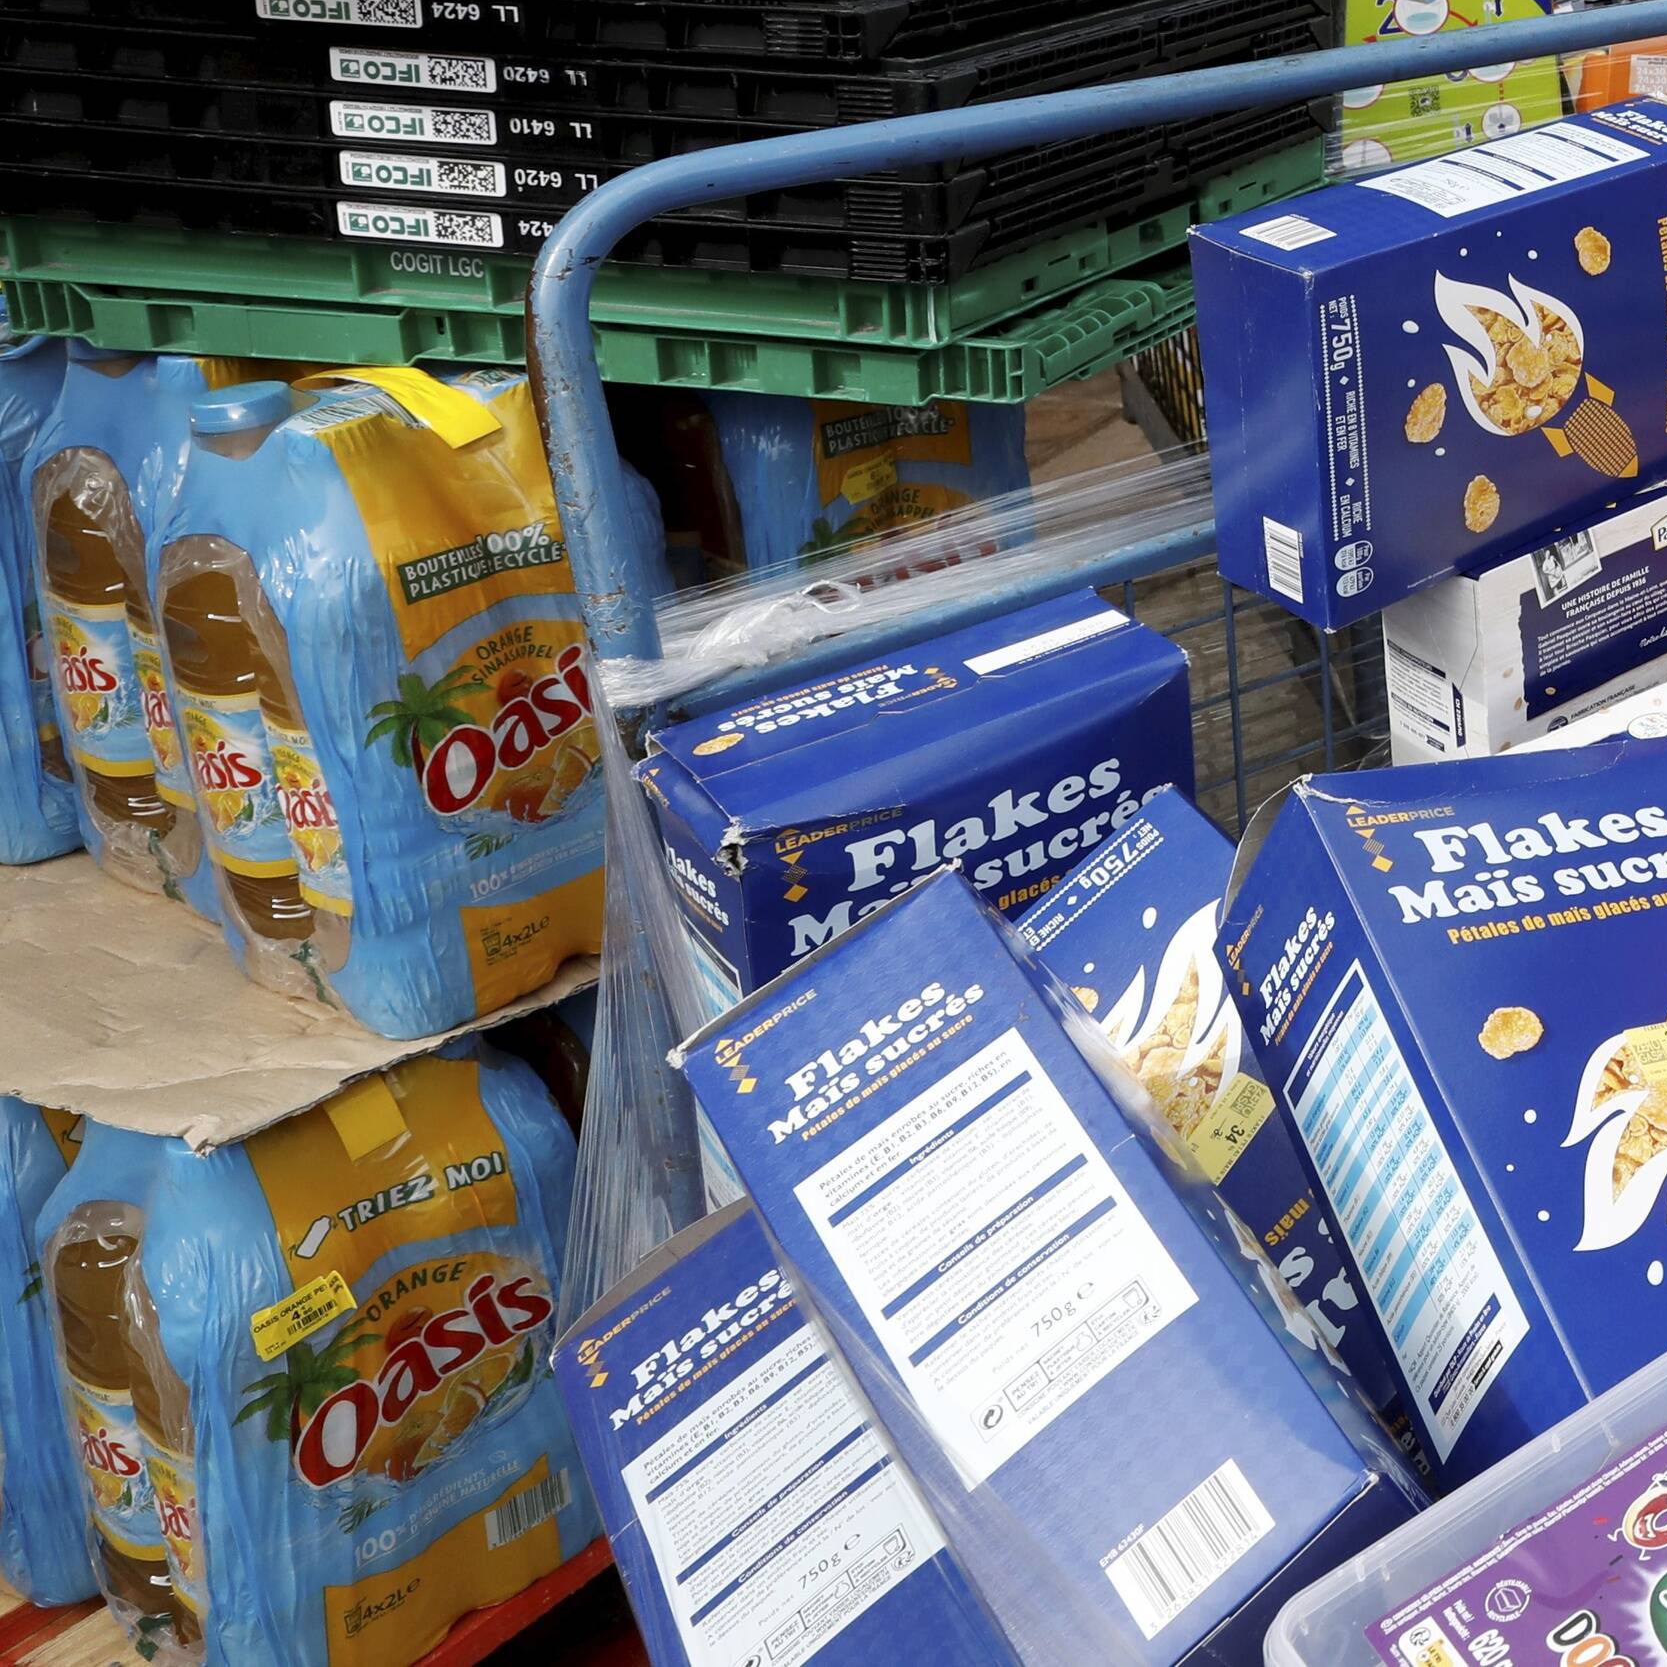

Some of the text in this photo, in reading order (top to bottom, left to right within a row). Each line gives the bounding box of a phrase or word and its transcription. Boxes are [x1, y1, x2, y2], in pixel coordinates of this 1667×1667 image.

[431, 1, 519, 23] LL 6424
[363, 60, 421, 83] IFCO
[503, 66, 549, 84] 6420
[367, 114, 424, 135] IFCO
[509, 117, 592, 139] LL 6410
[1590, 110, 1631, 130] Maïs
[375, 165, 432, 186] IFCO
[514, 168, 562, 187] 6420
[372, 215, 429, 237] IFCO
[390, 250, 484, 278] COGIT LGC
[1337, 296, 1348, 318] POIDS
[1329, 317, 1353, 372] 750g
[1337, 436, 1347, 452] FER
[1346, 390, 1360, 469] RICHE VITAMINES
[1341, 508, 1352, 538] CALCIUM
[1353, 501, 1363, 524] RICHE
[1561, 565, 1650, 612] UNE HISTOIRE FAMILLE
[1566, 584, 1632, 620] FRANÇAISE DEPUIS
[476, 625, 534, 661] ORANGE
[836, 664, 919, 694] Maïs
[716, 691, 833, 733] sucrés
[754, 681, 904, 734] Flakes
[775, 807, 904, 854] LEADERPRICE
[844, 756, 1122, 891] Flakes
[1346, 806, 1455, 828] LEADERPRICE
[1079, 842, 1139, 888] 750g
[998, 874, 1062, 913] glacés
[1387, 868, 1545, 925] Maïs
[1227, 904, 1265, 968] LEADERPRICE
[1447, 919, 1519, 945] Pétales
[1522, 914, 1546, 932] de
[1547, 904, 1592, 928] maïs
[1594, 894, 1651, 920] glacés
[1258, 906, 1317, 1009] Flakes
[1259, 989, 1295, 1046] Maïs
[1288, 911, 1336, 995] sucrés
[715, 987, 819, 1066] LEADERPRICE
[784, 981, 946, 1104] Flakes
[766, 983, 985, 1146] Maïs sucrés
[801, 1014, 974, 1142] Pétales de maïs glacés au sucre
[908, 1129, 955, 1166] Ingrédients
[338, 1151, 505, 1232] TRIEZ MOI
[937, 1195, 1035, 1273] Conseils préparation
[366, 1261, 467, 1324] ORANGE
[957, 1233, 1070, 1326] Conditions conservation
[253, 1292, 313, 1334] OASIS ORANGE
[576, 1285, 673, 1364] LEADERPRICE
[630, 1267, 781, 1390] Flakes
[295, 1274, 552, 1490] Oasis
[608, 1357, 695, 1431] Maïs
